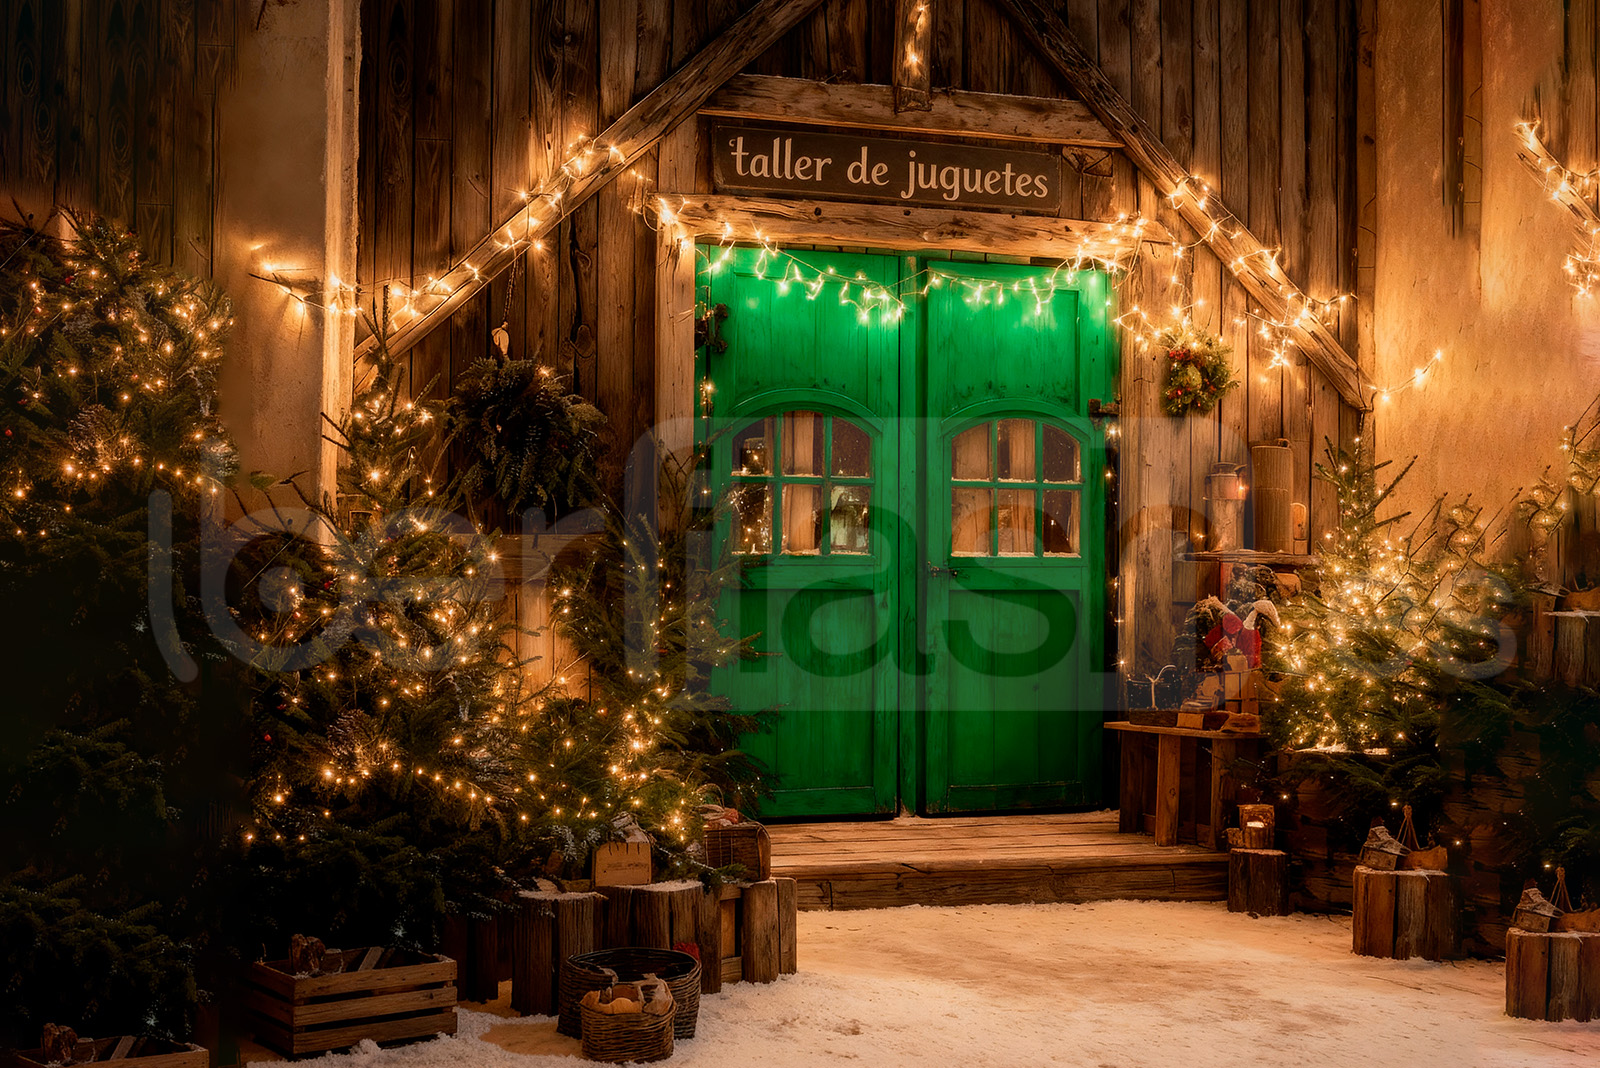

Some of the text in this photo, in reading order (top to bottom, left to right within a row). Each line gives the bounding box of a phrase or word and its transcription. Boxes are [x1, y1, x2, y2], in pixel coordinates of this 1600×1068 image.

[728, 135, 1049, 201] taller de juguetes
